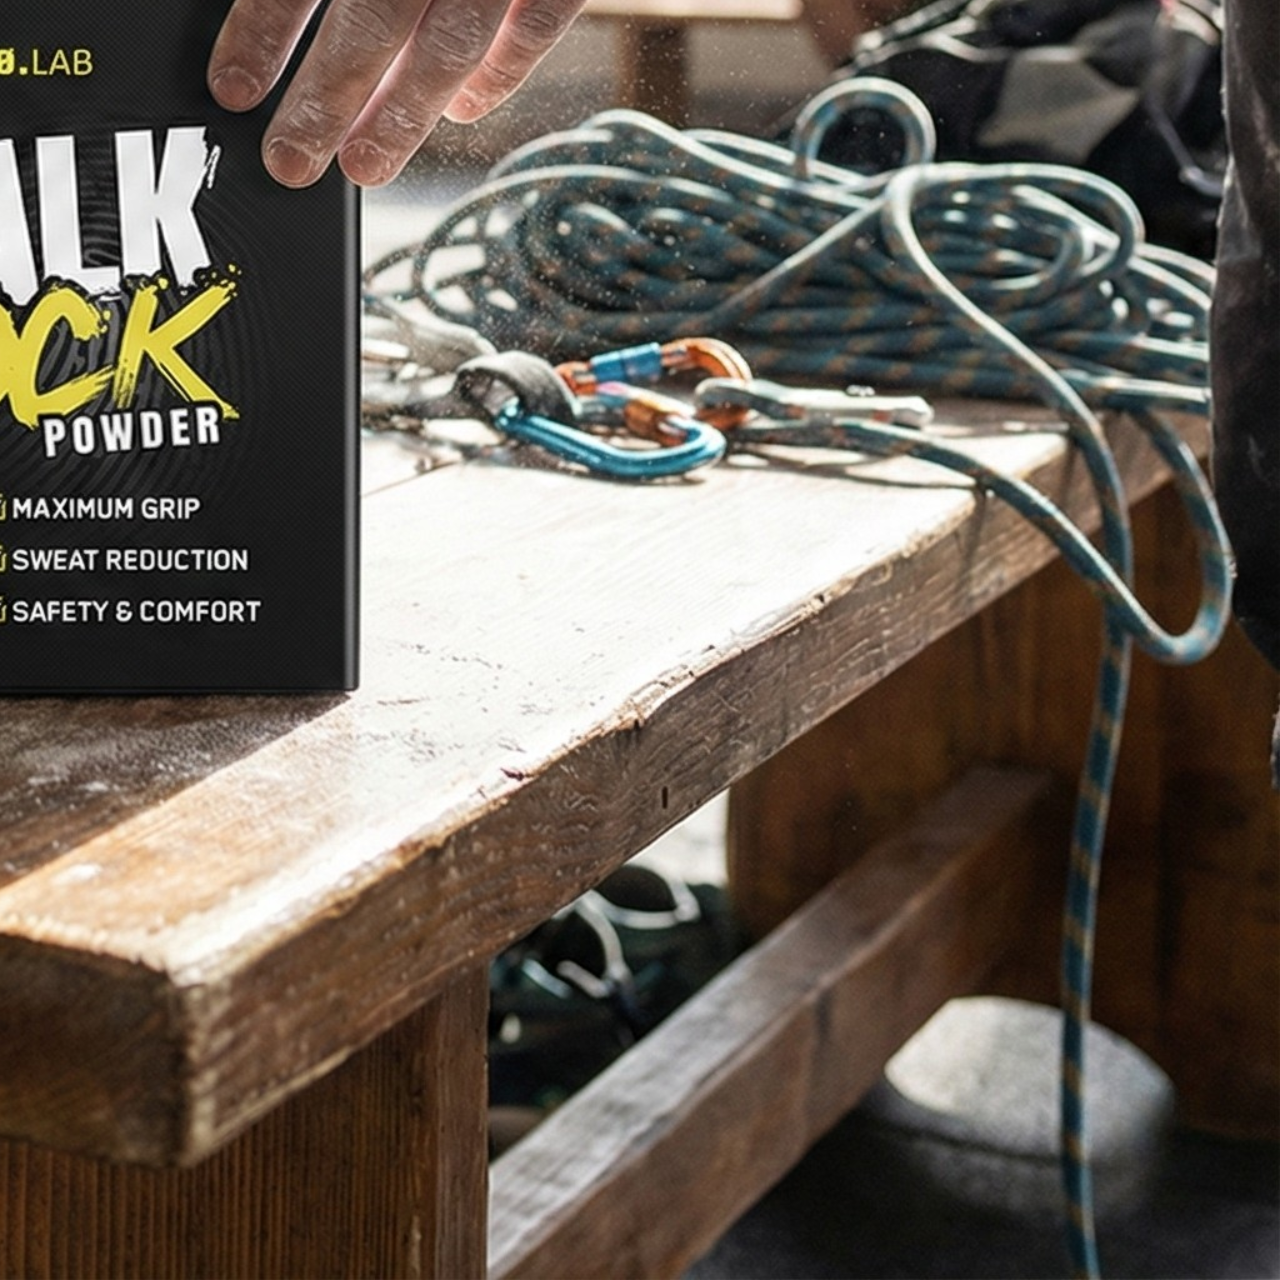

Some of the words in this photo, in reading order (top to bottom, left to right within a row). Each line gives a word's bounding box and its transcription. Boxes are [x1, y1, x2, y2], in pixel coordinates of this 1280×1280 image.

[43, 407, 221, 457] POWDER
[12, 497, 134, 520] MAXIMUM
[141, 497, 201, 520] GRIP
[12, 548, 100, 571] SWEAT
[106, 548, 248, 571] REDUCTION
[12, 600, 109, 622] SAFETY
[115, 600, 133, 622] &
[139, 600, 262, 622] COMFORT
